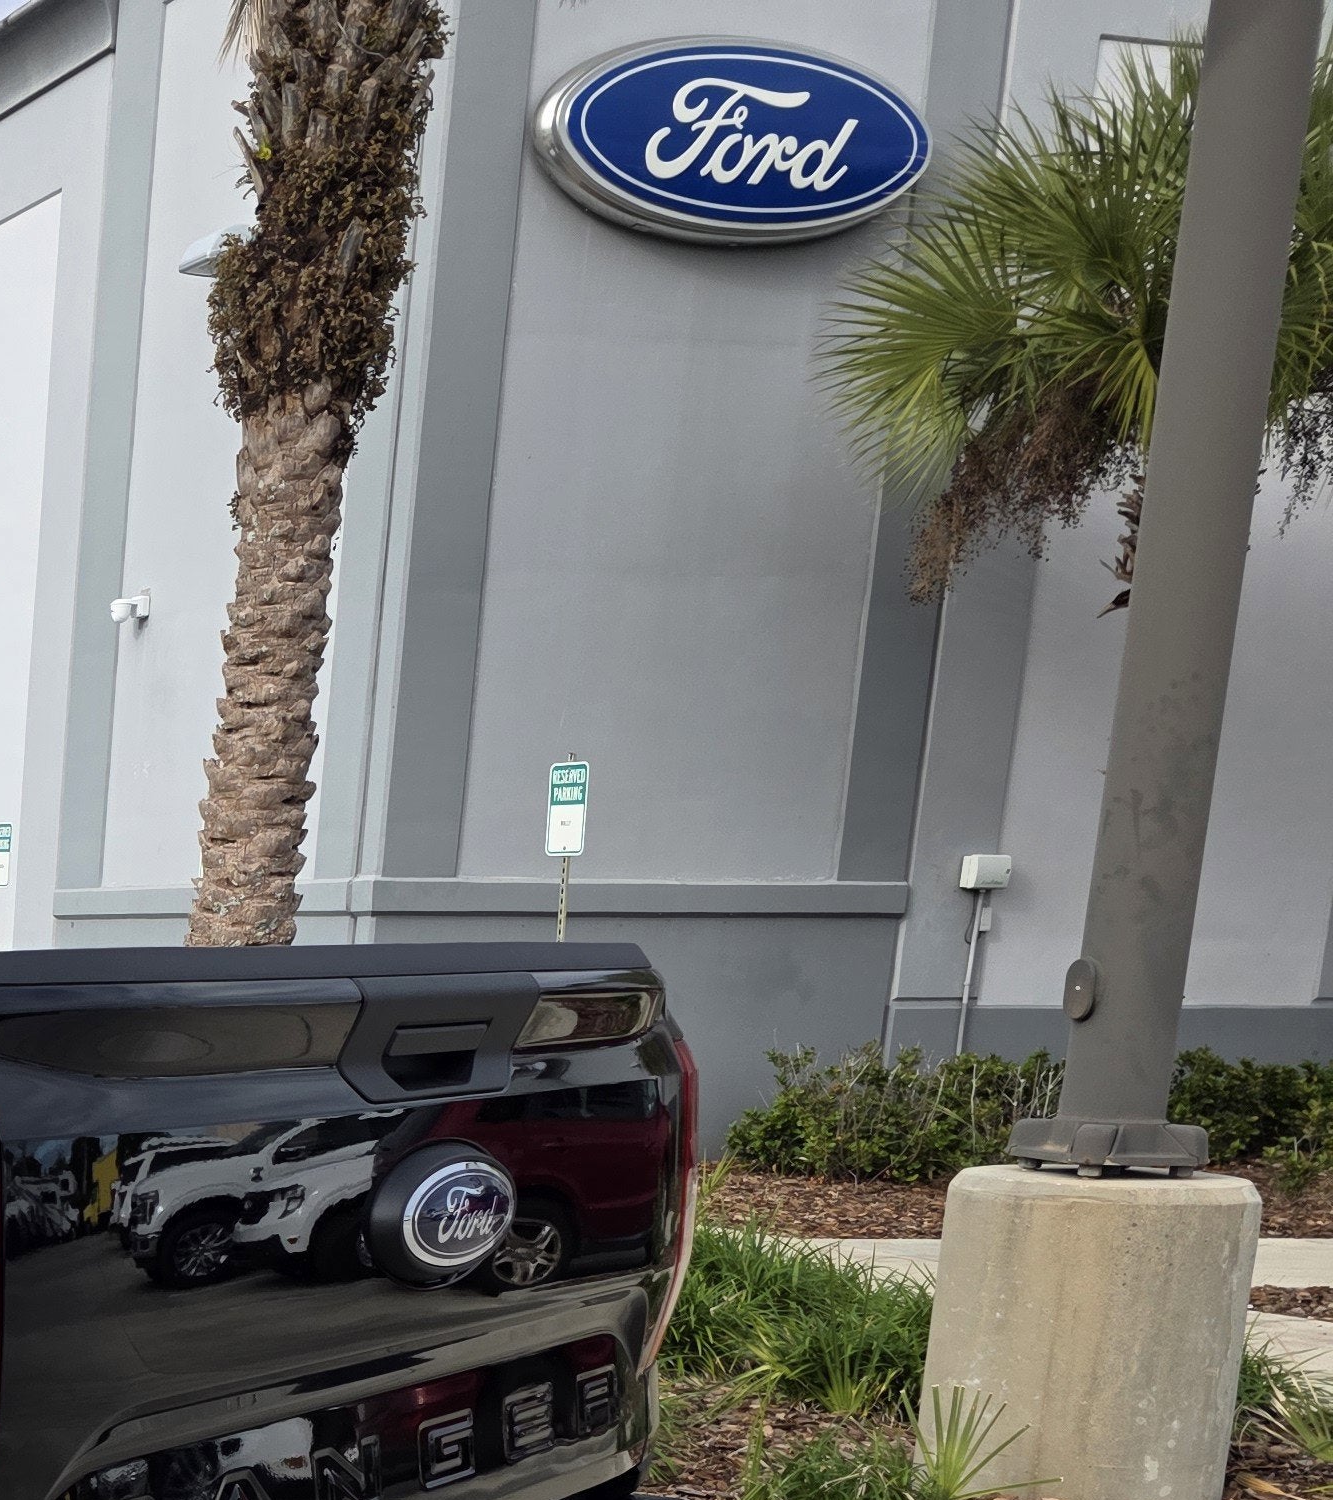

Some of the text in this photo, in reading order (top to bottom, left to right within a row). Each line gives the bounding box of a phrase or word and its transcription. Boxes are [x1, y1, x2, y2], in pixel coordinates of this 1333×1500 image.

[645, 77, 860, 192] Ford
[552, 768, 586, 784] RESERVED
[553, 786, 584, 802] PARKING
[437, 1185, 500, 1244] Ford
